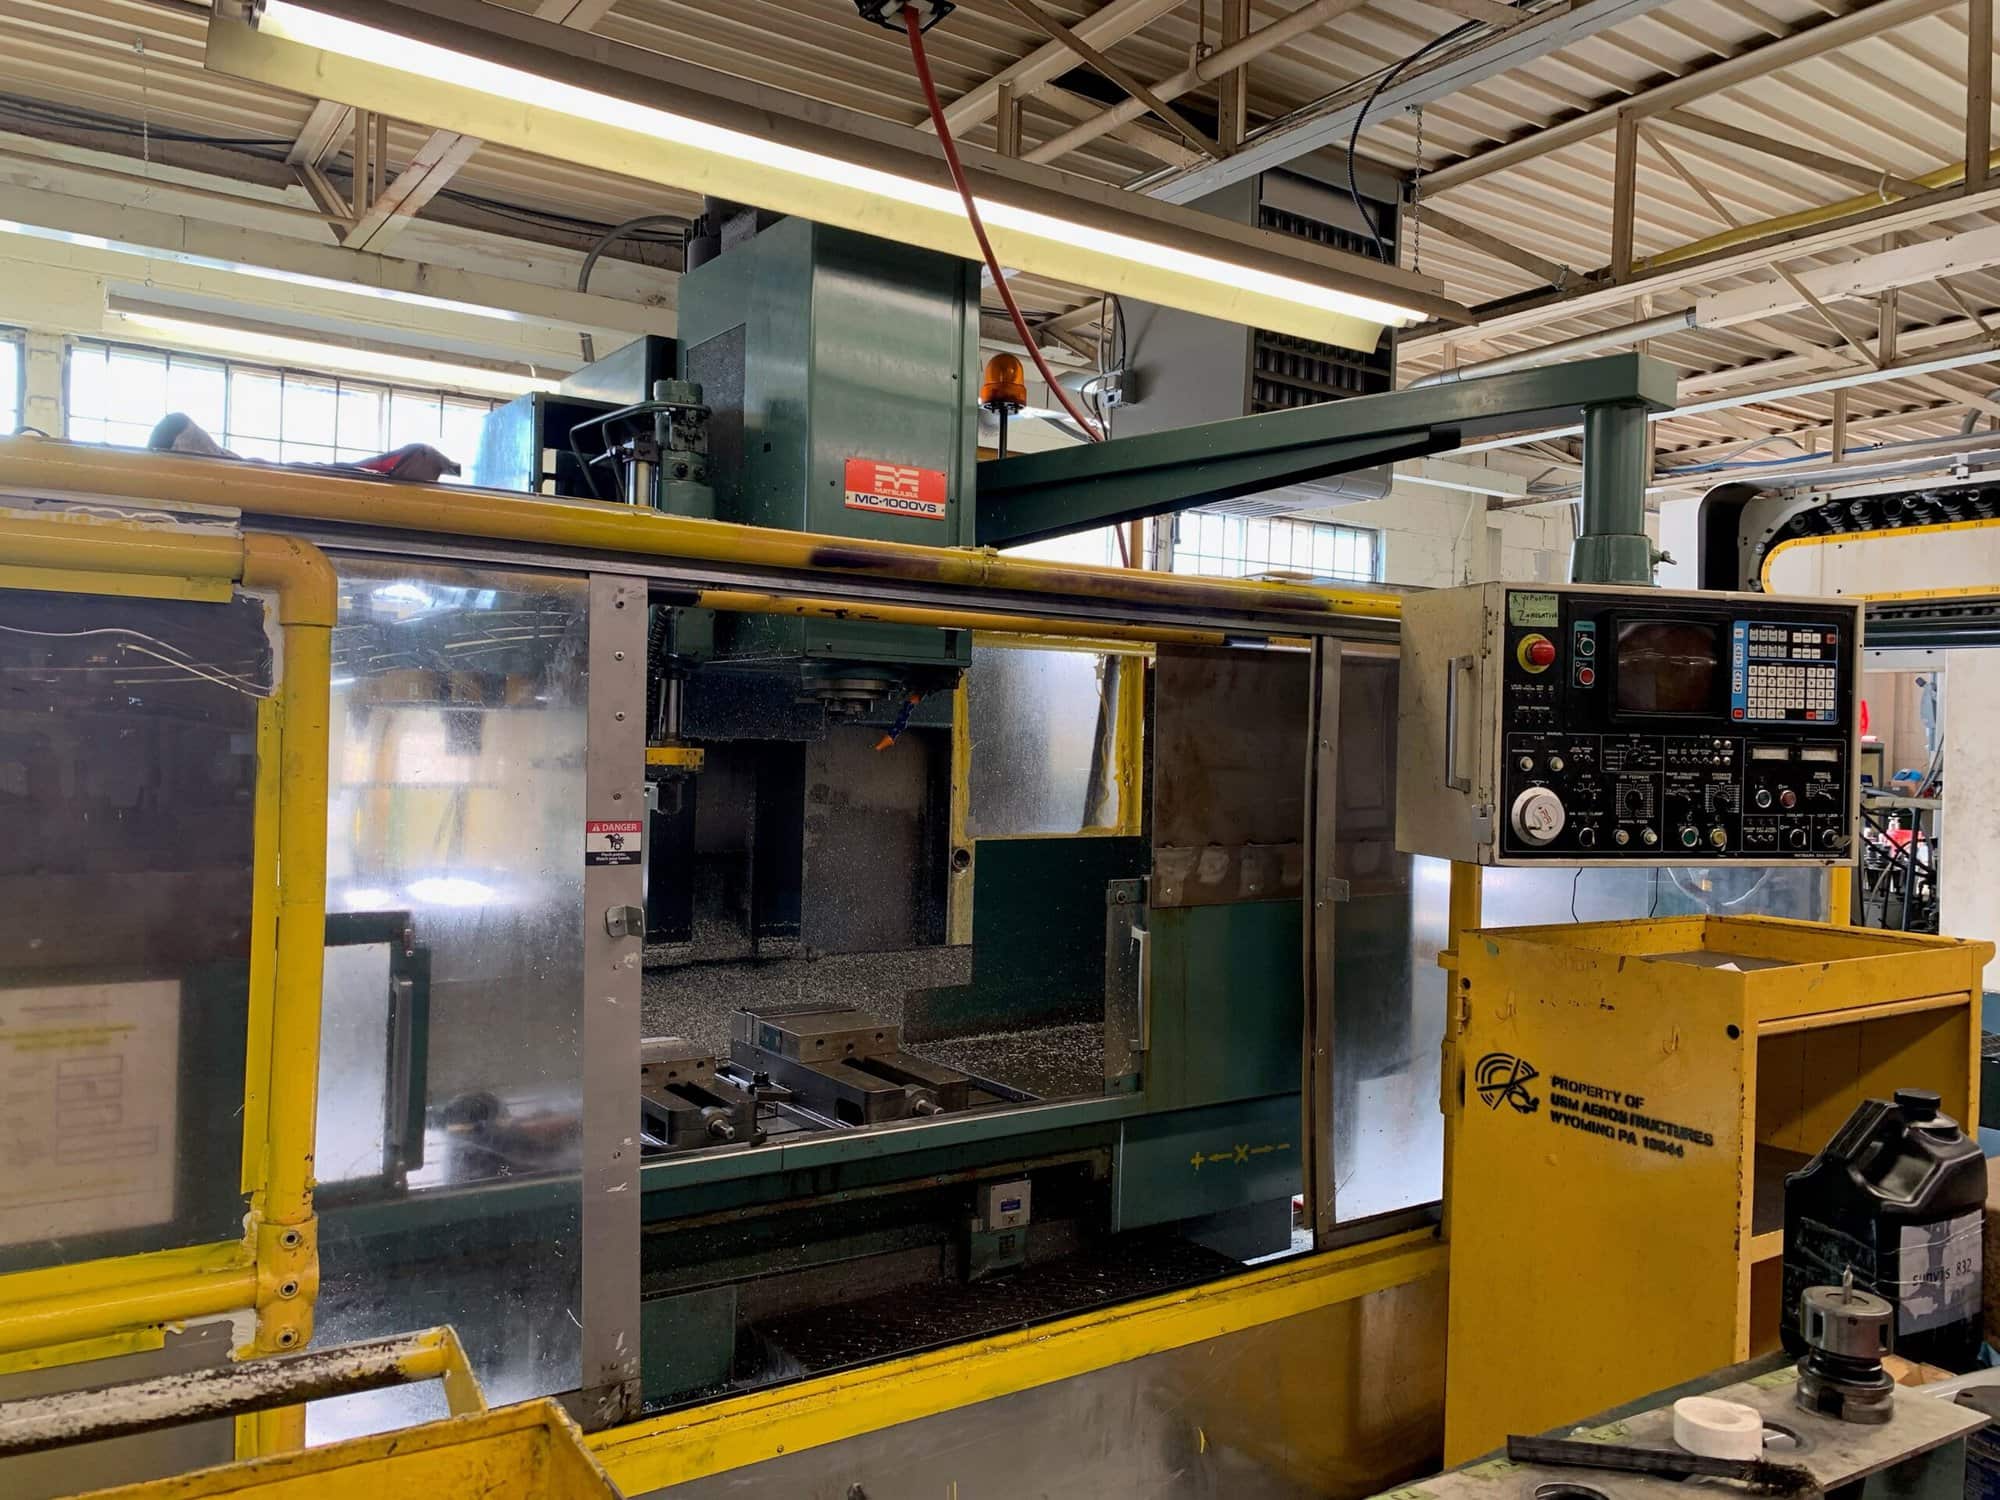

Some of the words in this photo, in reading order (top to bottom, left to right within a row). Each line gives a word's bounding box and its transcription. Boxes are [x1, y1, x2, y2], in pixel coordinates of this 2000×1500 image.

[602, 823, 637, 831] DANGER
[1551, 1076, 1622, 1104] PROPERTY
[1626, 1094, 1645, 1110] OF
[1550, 1094, 1579, 1113] USM
[1582, 1102, 1714, 1147] AEROSTRUCTURES
[1550, 1112, 1614, 1139] WYOMING
[1617, 1131, 1636, 1146] PA
[1956, 1258, 1972, 1275] 832
